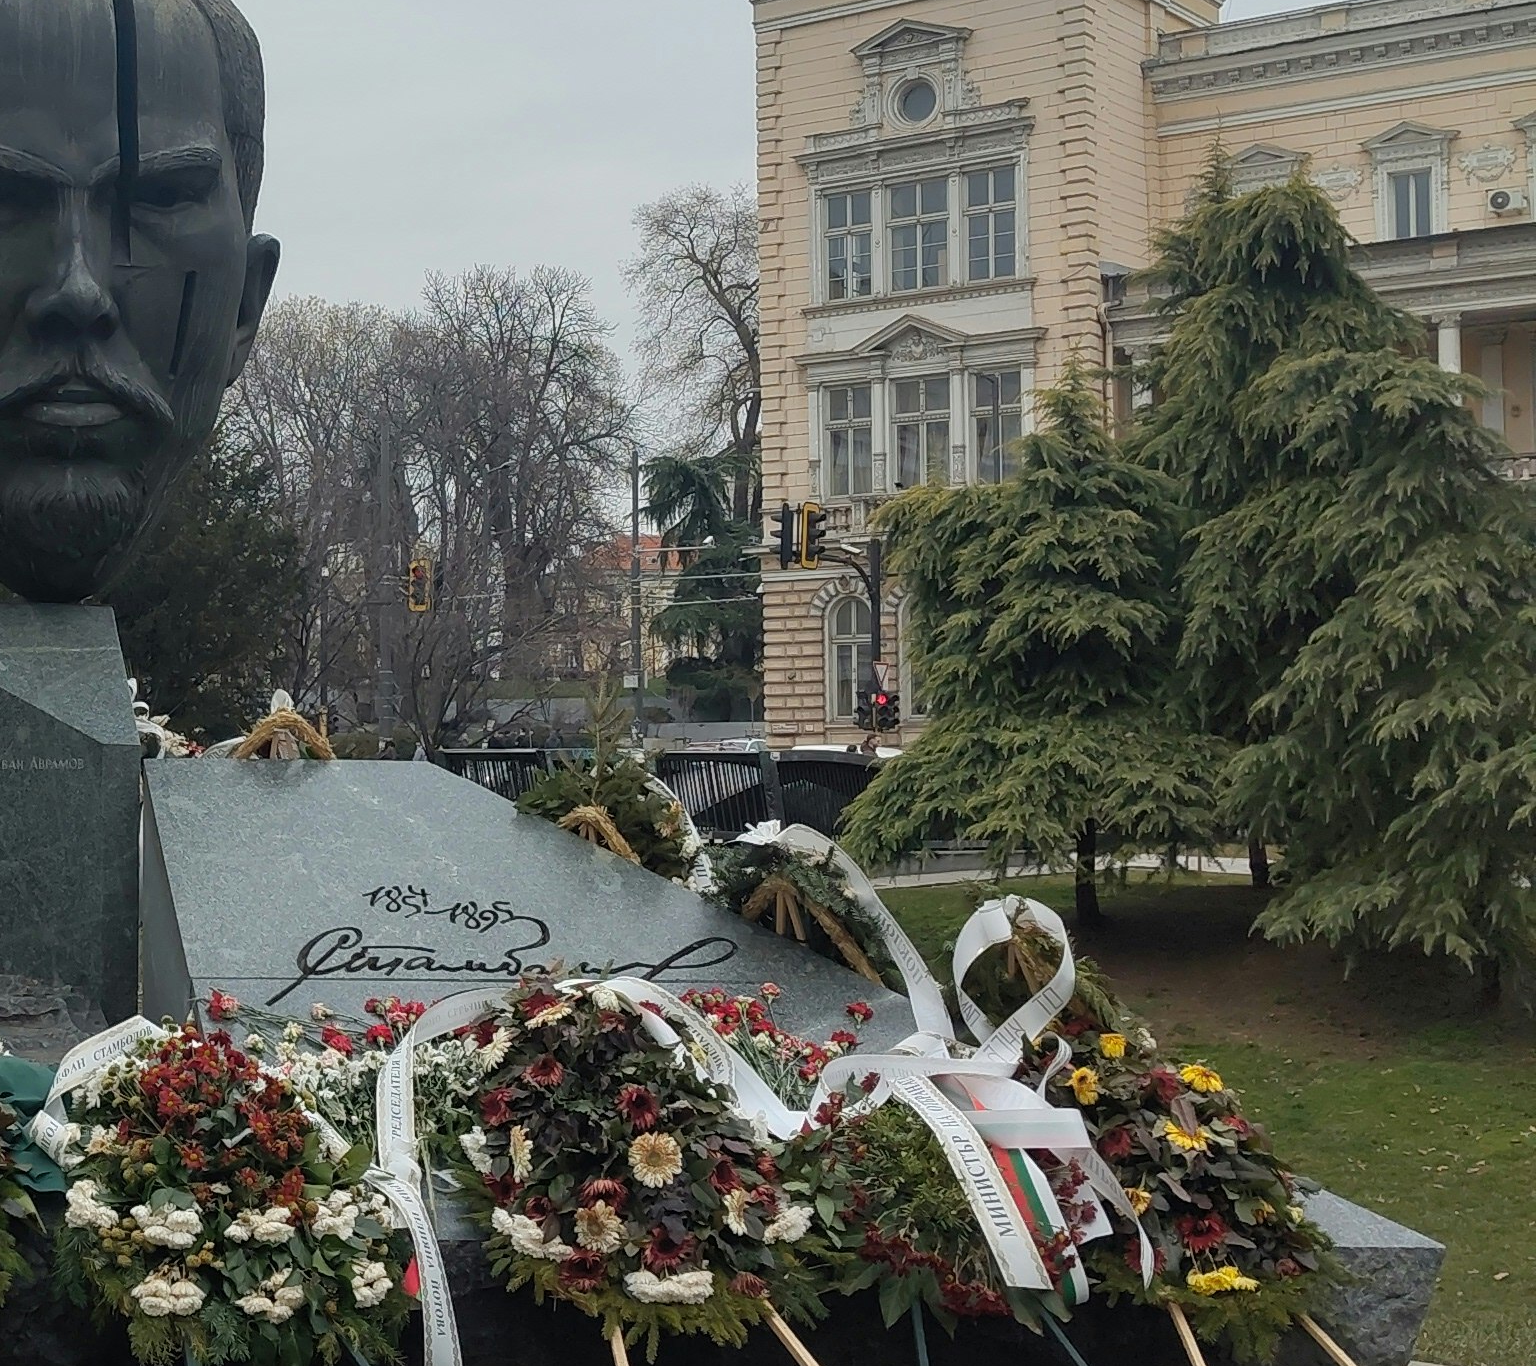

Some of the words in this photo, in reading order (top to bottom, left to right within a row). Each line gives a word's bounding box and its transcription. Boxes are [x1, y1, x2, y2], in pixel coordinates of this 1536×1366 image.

[30, 757, 84, 770] АВРАМОВ
[93, 1025, 153, 1062] СТАМБОЛОВ
[936, 1114, 962, 1128] НА
[951, 1135, 1018, 1237] МИНИСТЪР
[412, 1211, 436, 1269] ИЛИЯНА
[430, 1278, 448, 1336] ЙОТОВА
